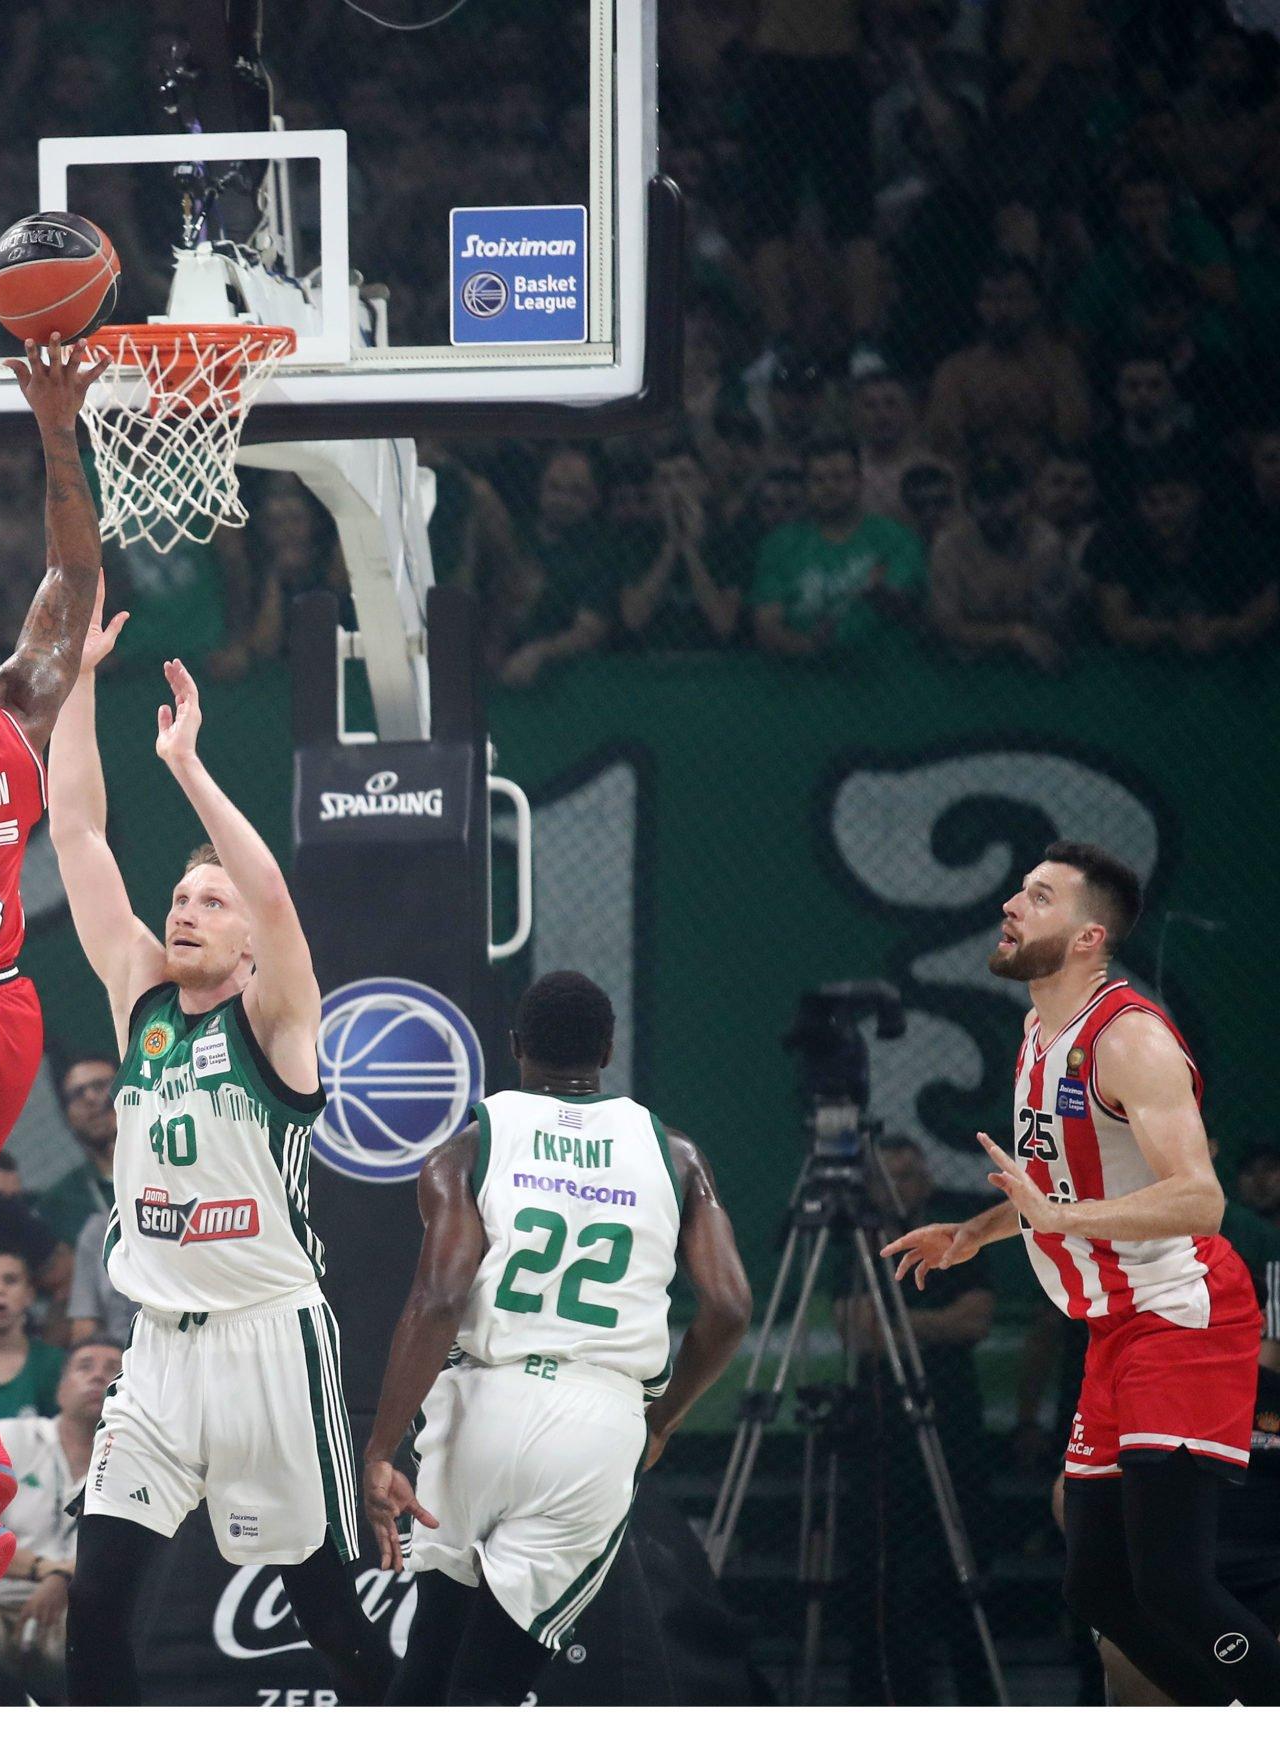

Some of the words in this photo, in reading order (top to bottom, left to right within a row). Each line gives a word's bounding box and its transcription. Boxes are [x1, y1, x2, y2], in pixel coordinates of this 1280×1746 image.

[461, 234, 577, 258] Stoiximan
[514, 274, 577, 293] Basket
[514, 293, 577, 315] League
[321, 787, 443, 821] SPALDING
[149, 1113, 198, 1167] 40
[1017, 1107, 1059, 1161] 25
[513, 1173, 637, 1207] more.com
[494, 1206, 634, 1330] 22
[524, 1353, 558, 1381] 22
